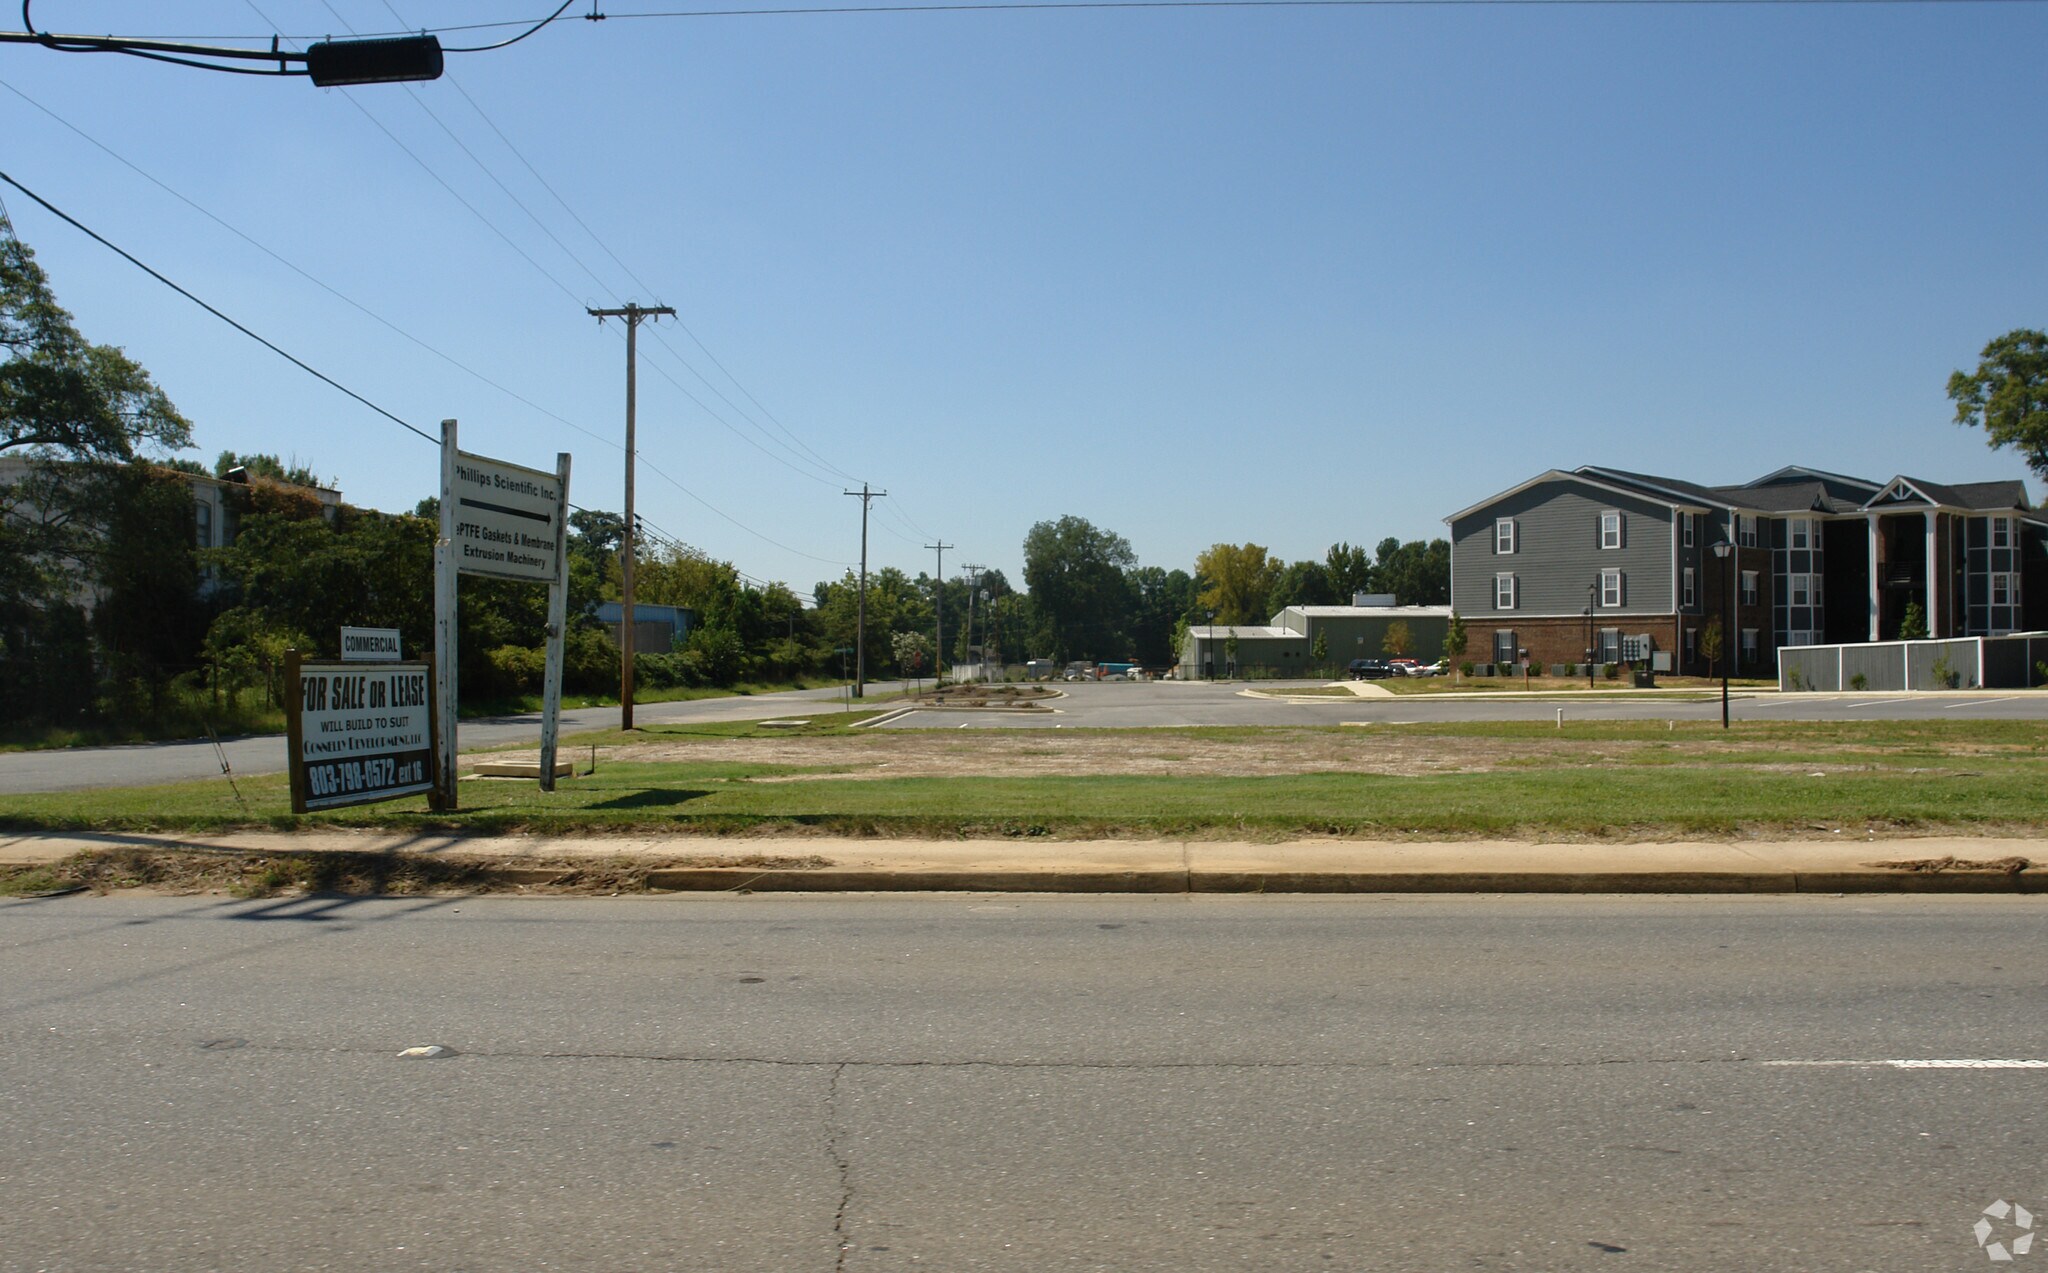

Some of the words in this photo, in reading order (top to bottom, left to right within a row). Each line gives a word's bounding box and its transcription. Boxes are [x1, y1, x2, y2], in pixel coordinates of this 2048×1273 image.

[494, 474, 538, 497] Scientific
[541, 486, 556, 502] Inc.
[482, 527, 512, 544] Gaskets
[514, 532, 519, 544] &
[464, 544, 504, 562] Extrusion
[507, 551, 546, 570] Machinery
[345, 636, 398, 652] COMMERCIAL
[302, 676, 327, 712] FOR
[332, 676, 366, 710] SALE
[370, 680, 386, 708] OR
[391, 676, 424, 707] LEASE
[320, 720, 343, 733] WILL
[346, 718, 372, 730] BUILD
[375, 717, 387, 728] TO
[390, 716, 409, 728] SUIT
[309, 758, 395, 796] 803-798-0572
[398, 764, 412, 784] ext
[412, 760, 422, 782] 16
